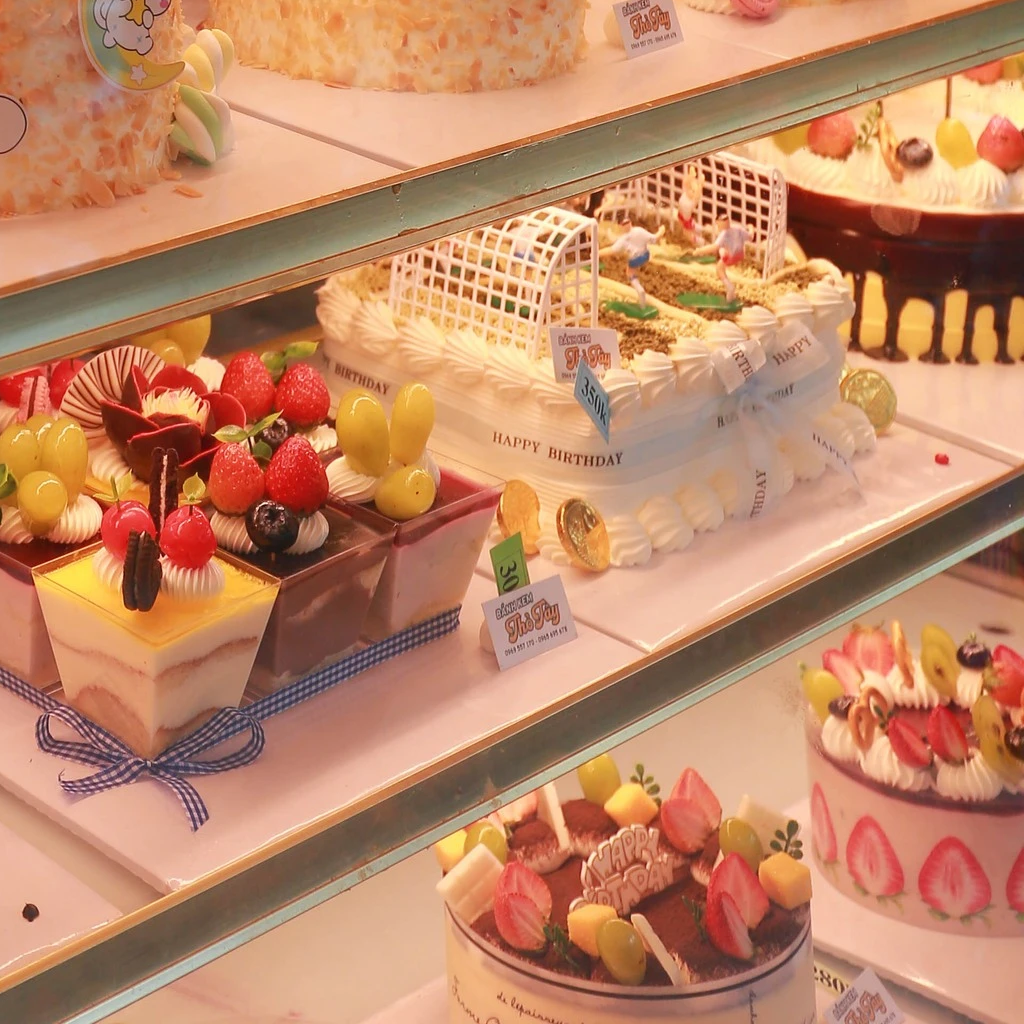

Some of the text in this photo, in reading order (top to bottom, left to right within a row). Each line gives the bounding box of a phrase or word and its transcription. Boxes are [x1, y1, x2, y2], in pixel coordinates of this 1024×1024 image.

[772, 335, 812, 366] HAPPY
[335, 363, 390, 395] BIRTHDAY
[581, 377, 607, 426] 350k
[492, 431, 624, 468] HAPPY BIRTHDAY
[516, 592, 534, 611] KEM
[505, 598, 561, 643] Thỏ Tây
[814, 966, 849, 994] 80
